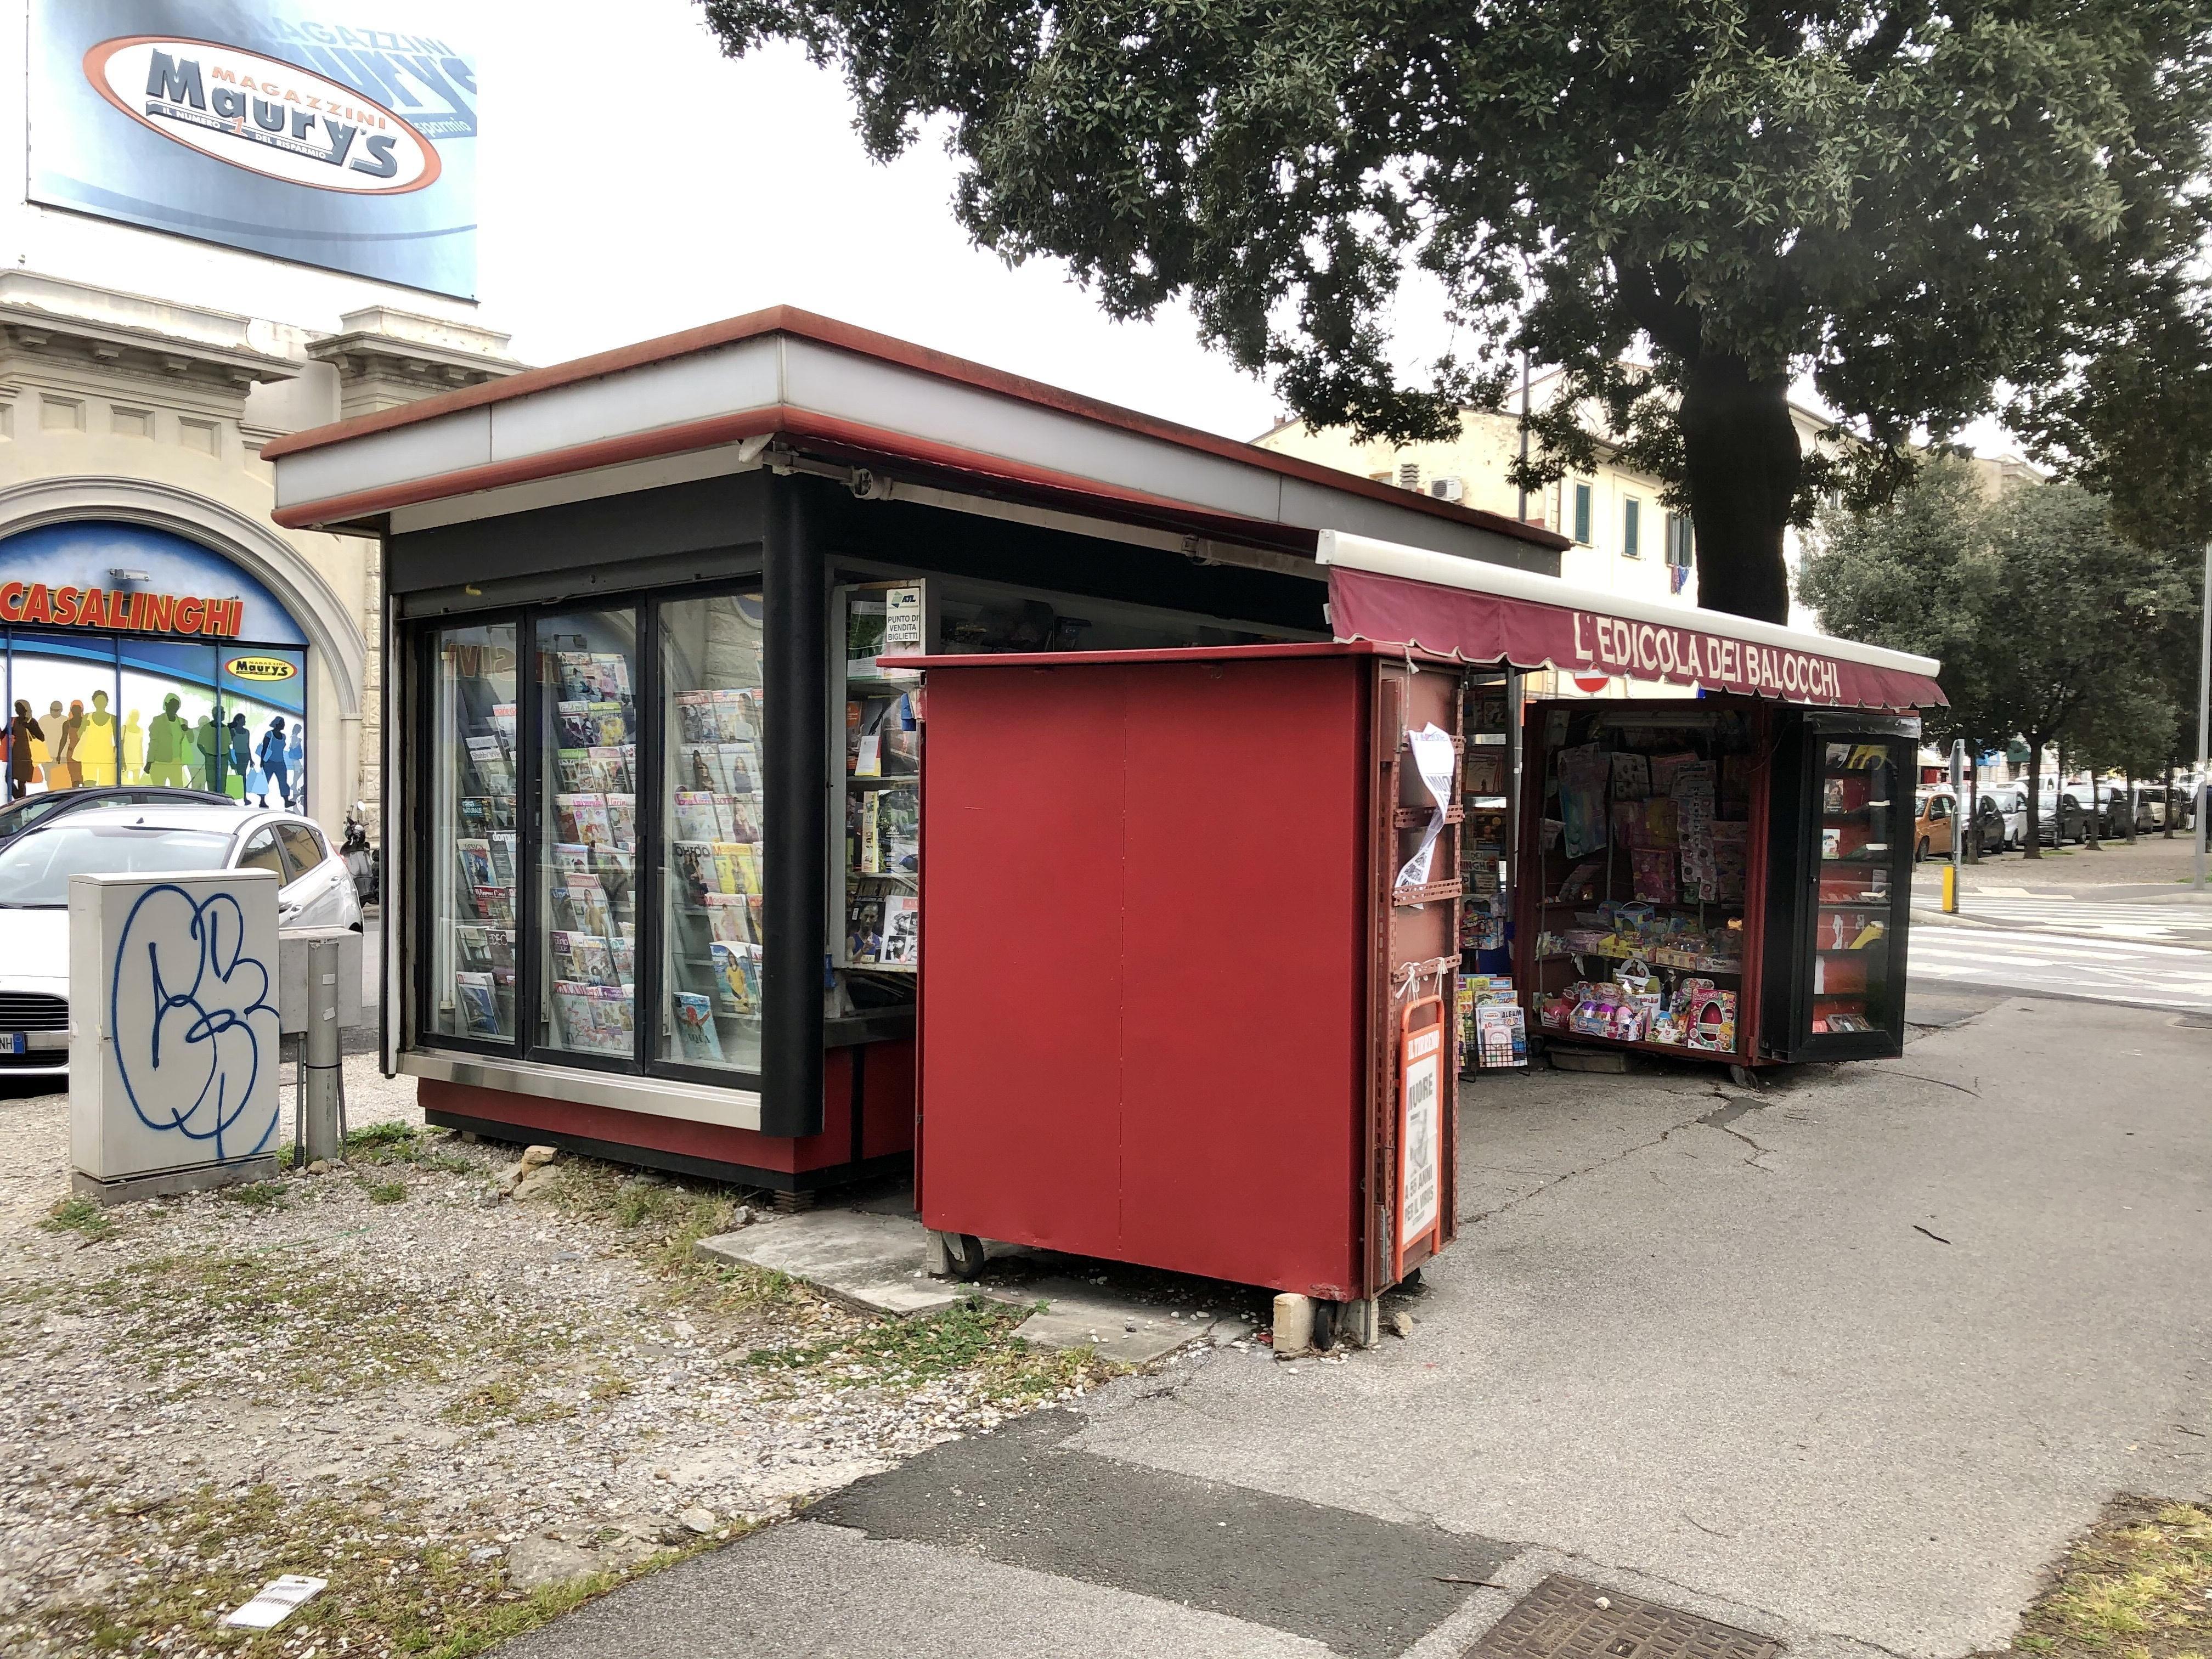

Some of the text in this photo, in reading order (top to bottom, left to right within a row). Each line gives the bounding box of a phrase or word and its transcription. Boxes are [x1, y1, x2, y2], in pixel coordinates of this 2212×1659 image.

[145, 48, 398, 179] Maury's
[212, 66, 386, 129] MAGAZZINI
[162, 107, 326, 160] IL NUMERO 1 DEL RISPARMIO
[0, 582, 244, 637] CASALINGHI
[888, 615, 910, 623] PUNTO
[889, 623, 917, 631] VENDITA
[888, 632, 918, 641] BIGLIETTI
[1707, 637, 1742, 684] DEI
[1745, 645, 1841, 698] BALOCCHI
[1502, 1009, 1522, 1019] ALBUM
[1414, 1030, 1440, 1058] TIRRENO
